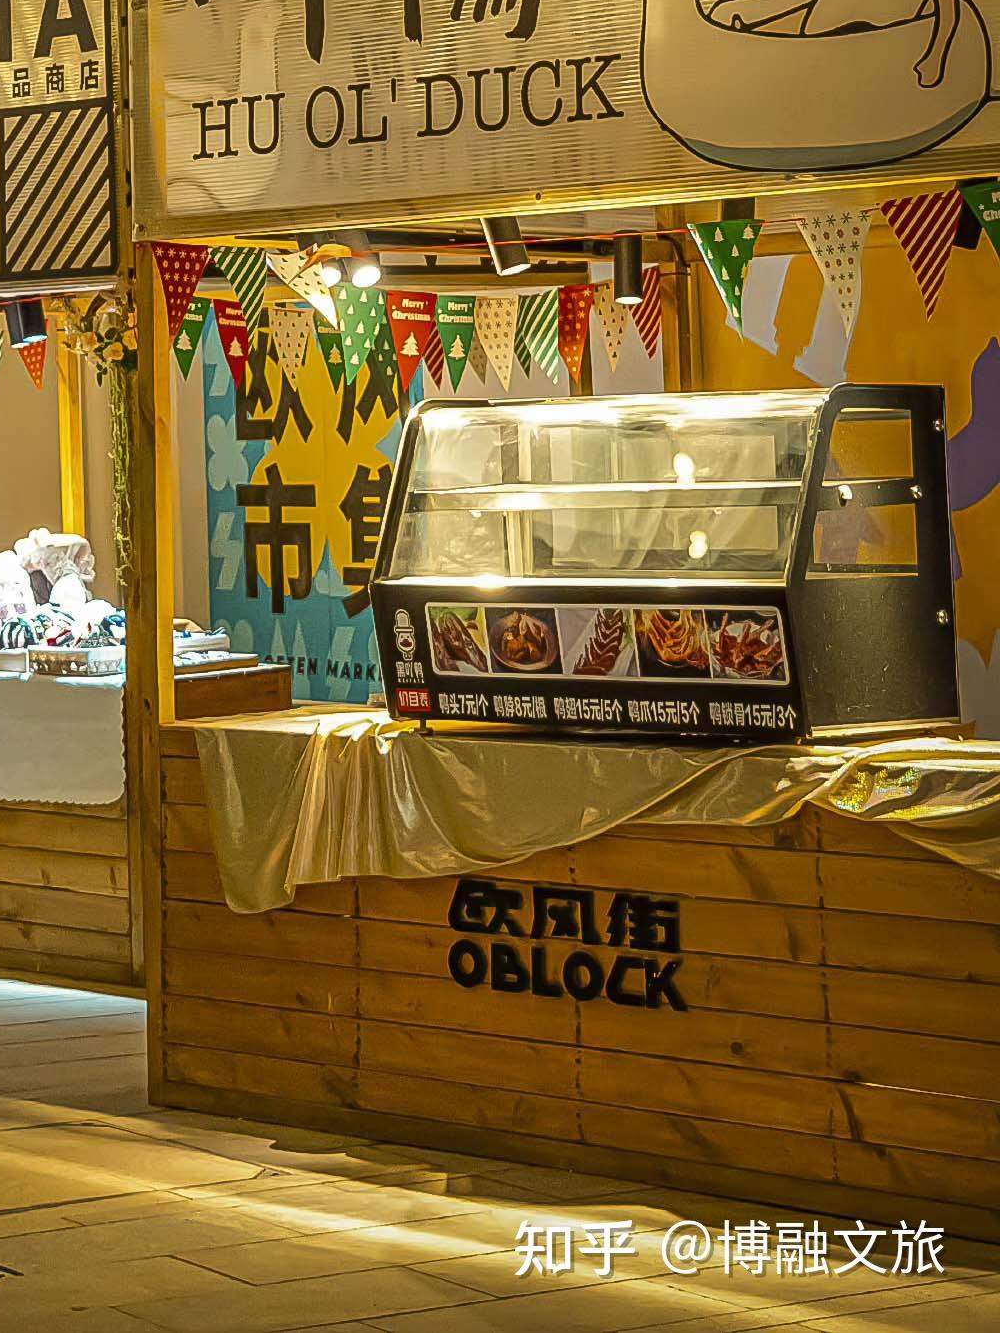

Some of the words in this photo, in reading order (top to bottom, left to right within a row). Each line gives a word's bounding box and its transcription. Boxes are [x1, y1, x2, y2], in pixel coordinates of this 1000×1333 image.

[191, 92, 286, 161] HU
[415, 54, 625, 136] DUCK
[447, 878, 681, 953] 欧风街
[447, 938, 689, 1012] OBLOCK
